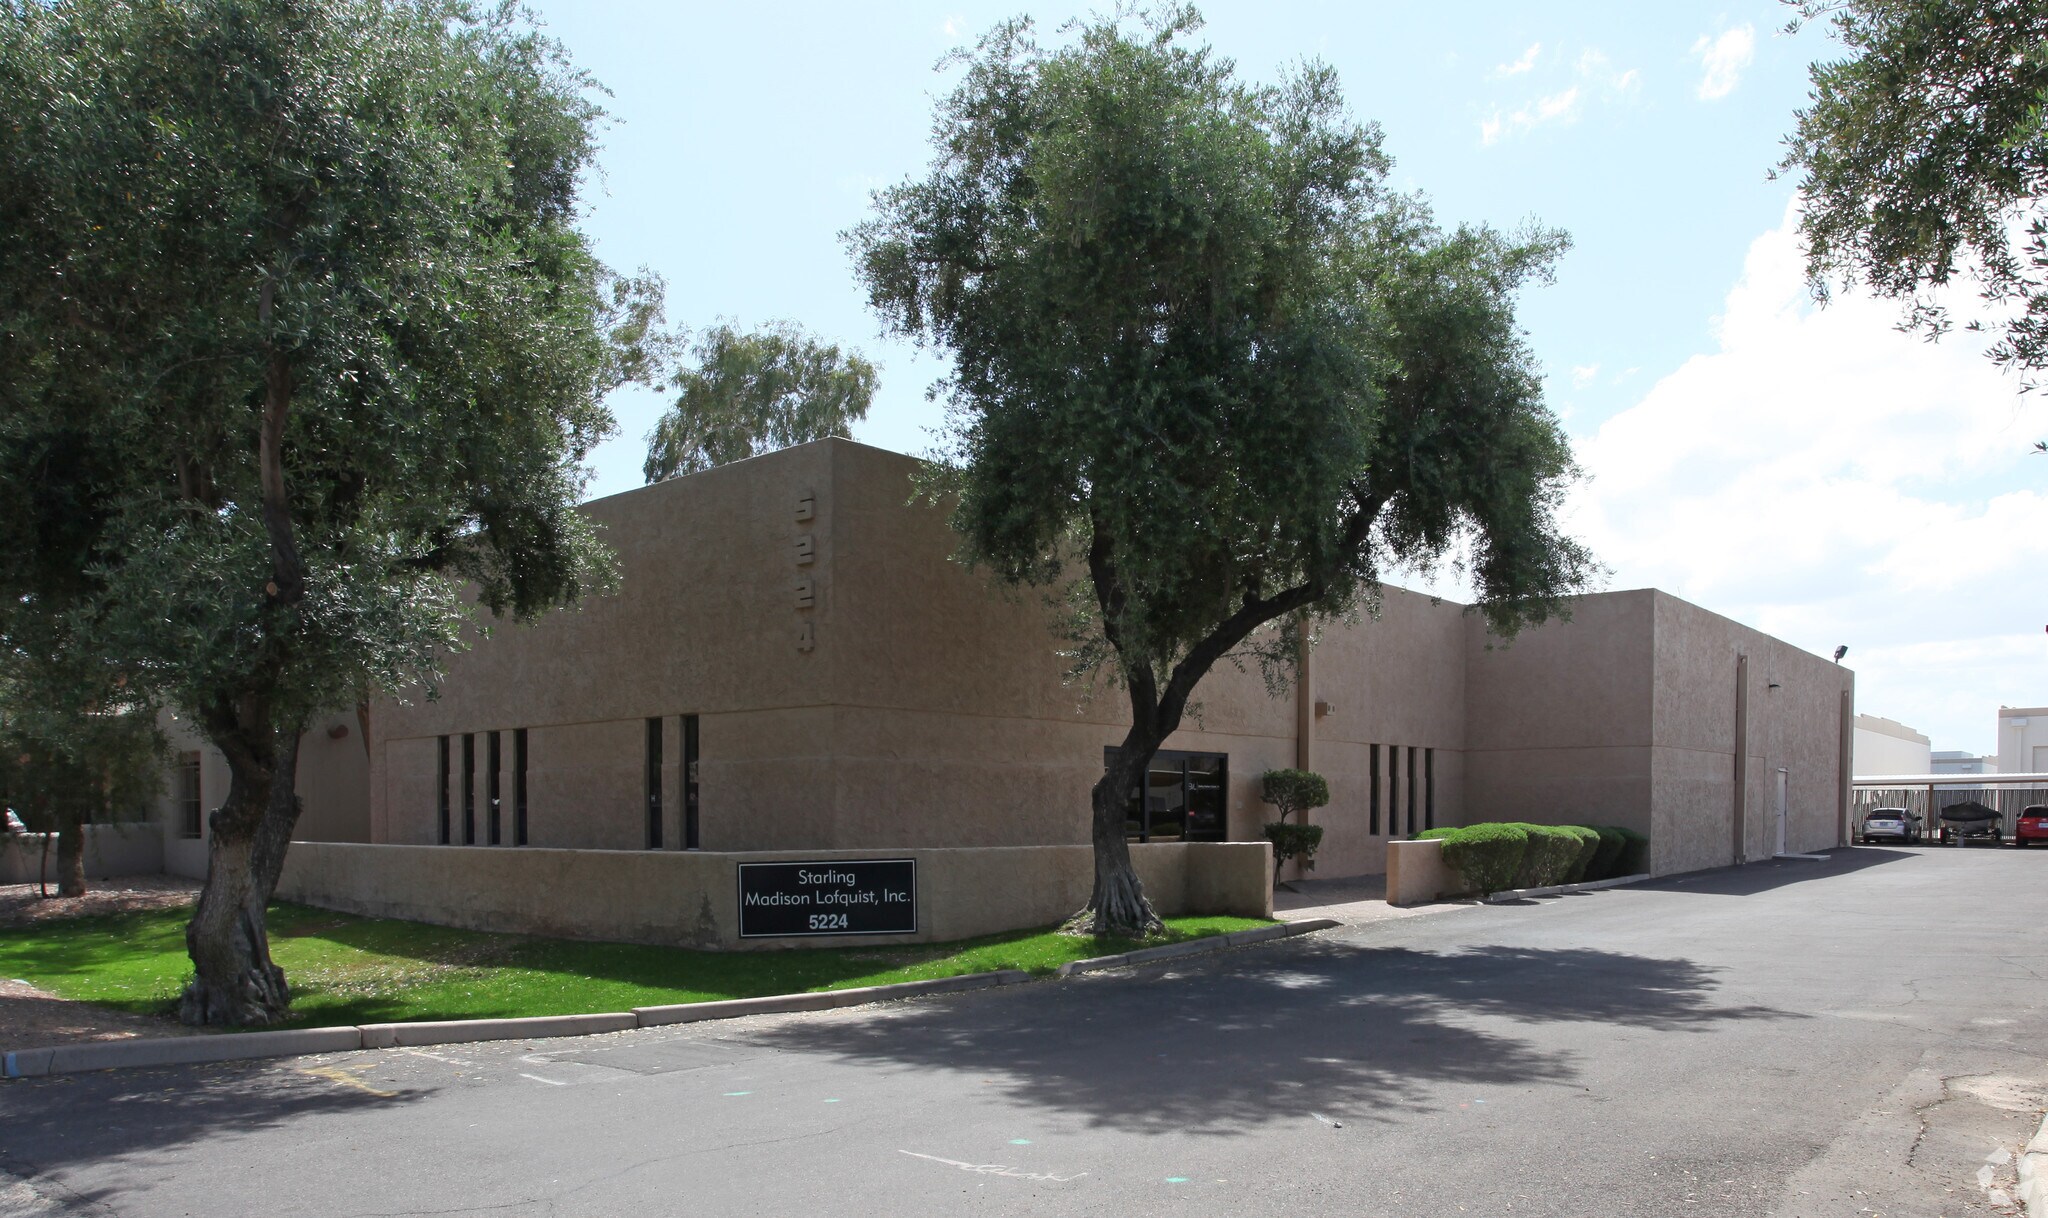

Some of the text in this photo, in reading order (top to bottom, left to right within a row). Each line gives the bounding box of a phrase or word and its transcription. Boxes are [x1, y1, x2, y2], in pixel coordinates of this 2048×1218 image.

[798, 869, 856, 887] Starling
[745, 888, 911, 907] Madison Lofquist, Inc.
[809, 913, 848, 930] 5224
